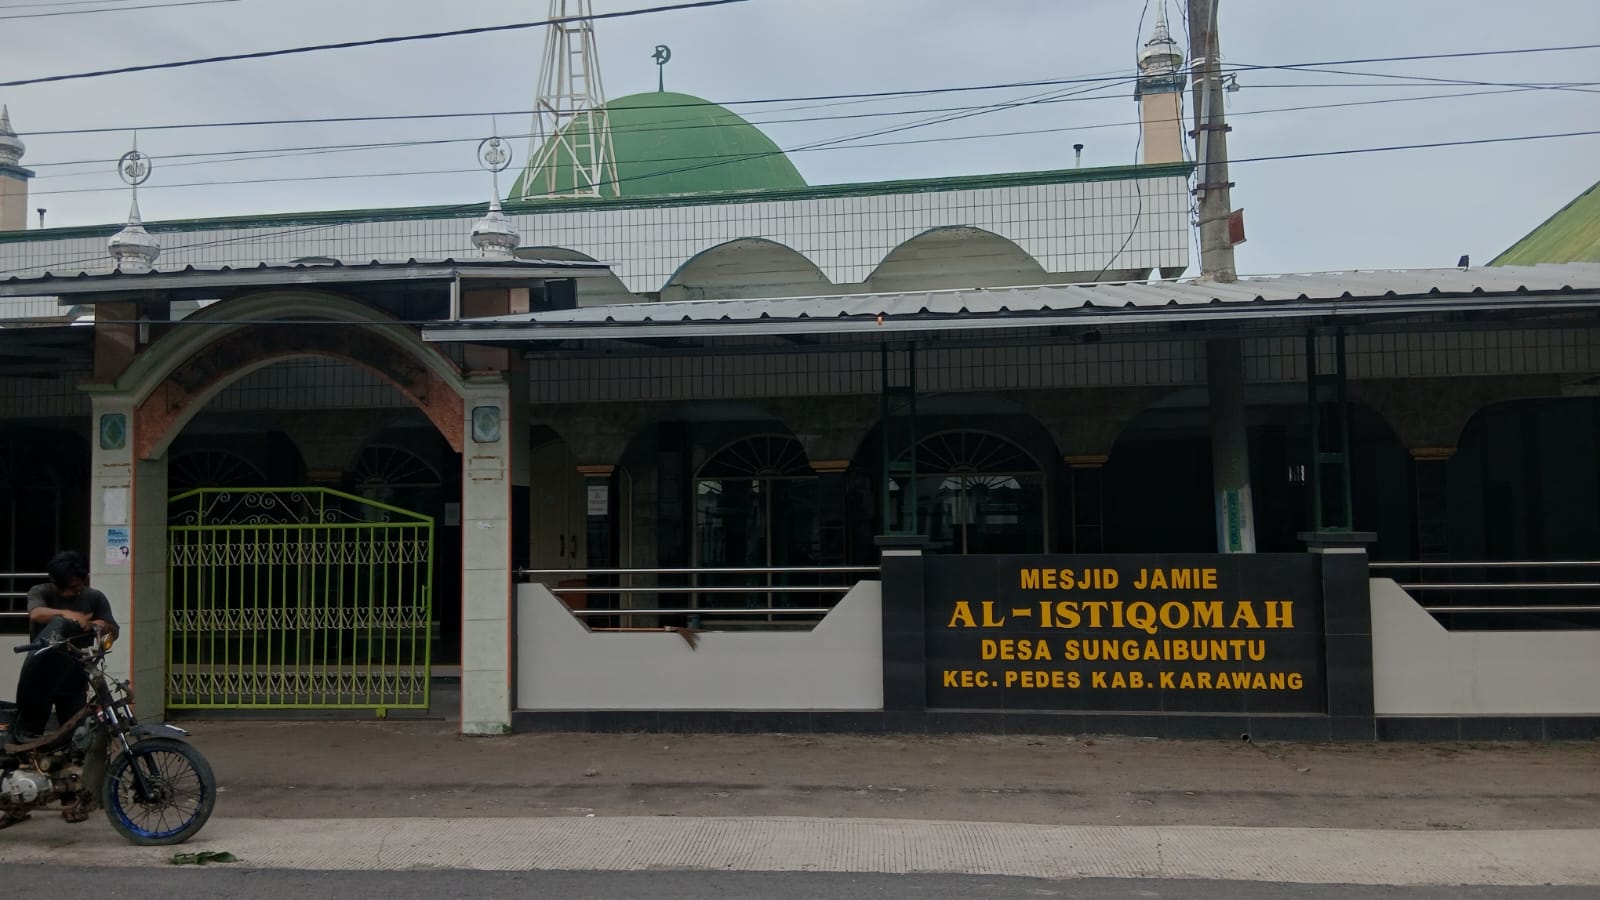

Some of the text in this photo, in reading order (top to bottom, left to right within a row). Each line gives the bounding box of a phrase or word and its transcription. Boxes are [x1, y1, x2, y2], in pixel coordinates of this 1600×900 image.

[1021, 568, 1217, 590] MESJID JAMIE
[981, 639, 1265, 661] DESA SUNGAIBUNTU
[943, 670, 1303, 689] KEC. PEDES KAB. KARAWANG
